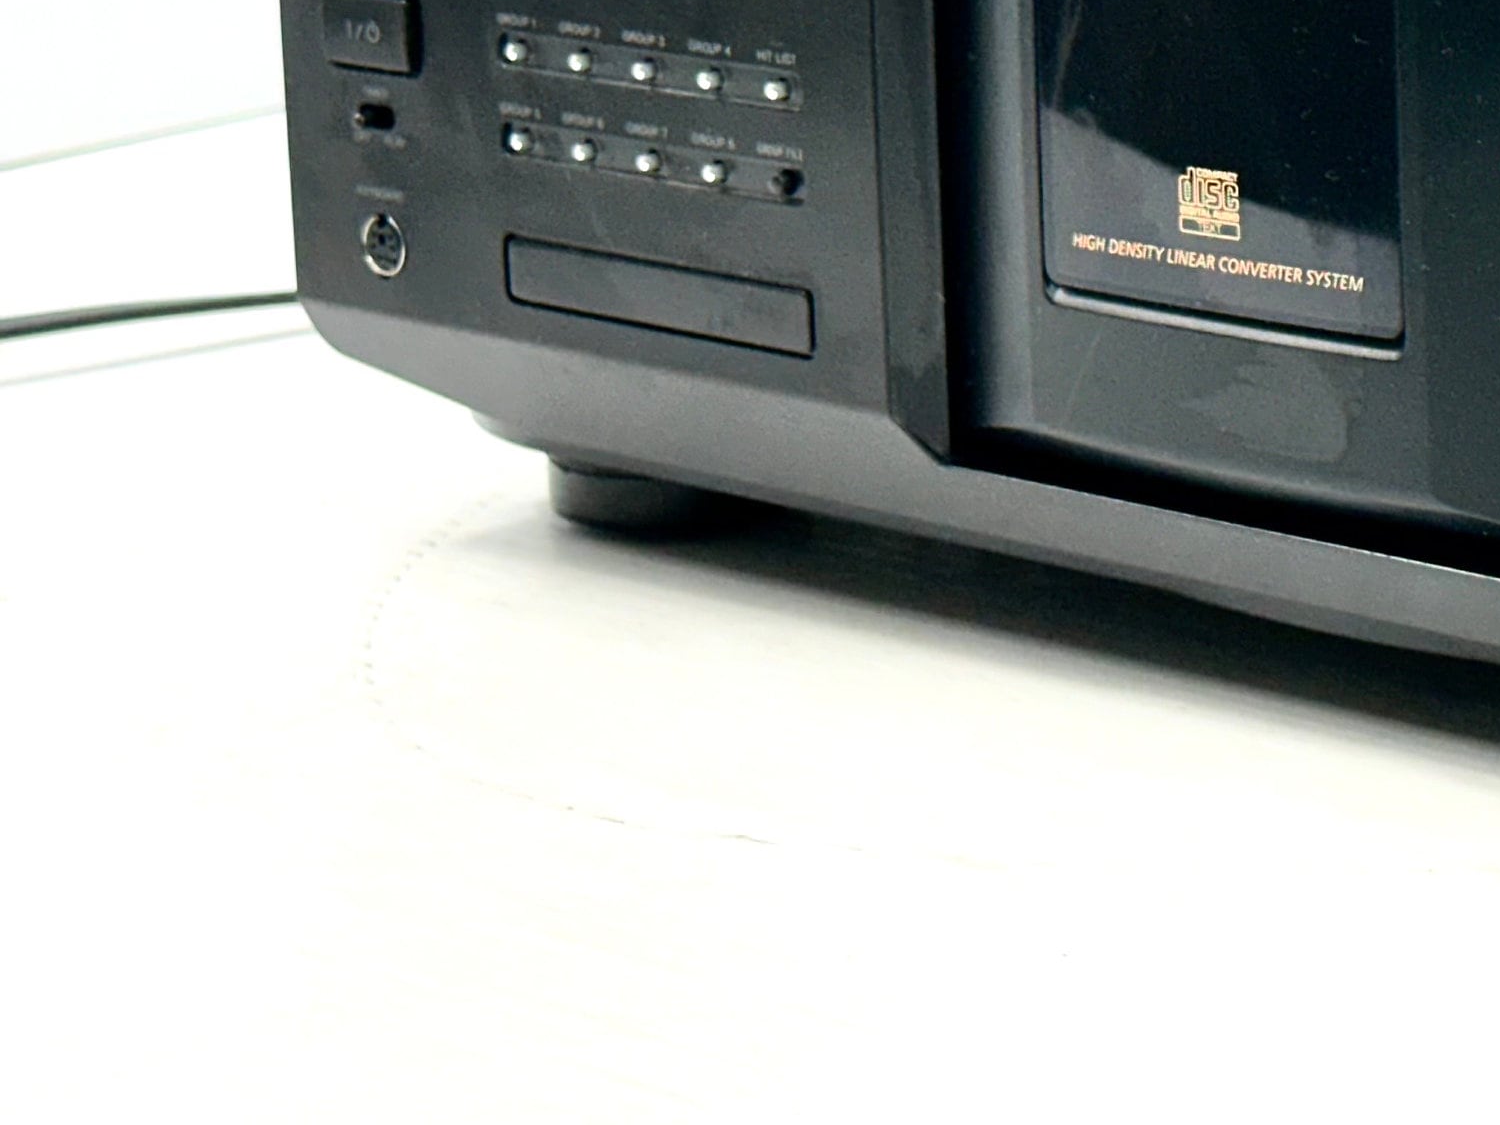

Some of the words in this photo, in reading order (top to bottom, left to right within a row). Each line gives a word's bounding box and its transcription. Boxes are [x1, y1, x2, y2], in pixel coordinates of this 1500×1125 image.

[1072, 232, 1105, 253] HIGH
[1109, 238, 1164, 262] DENSITY
[1167, 248, 1215, 271] LINEAR
[1218, 256, 1302, 284] CONVERTER
[1306, 269, 1364, 293] SYSTEM
